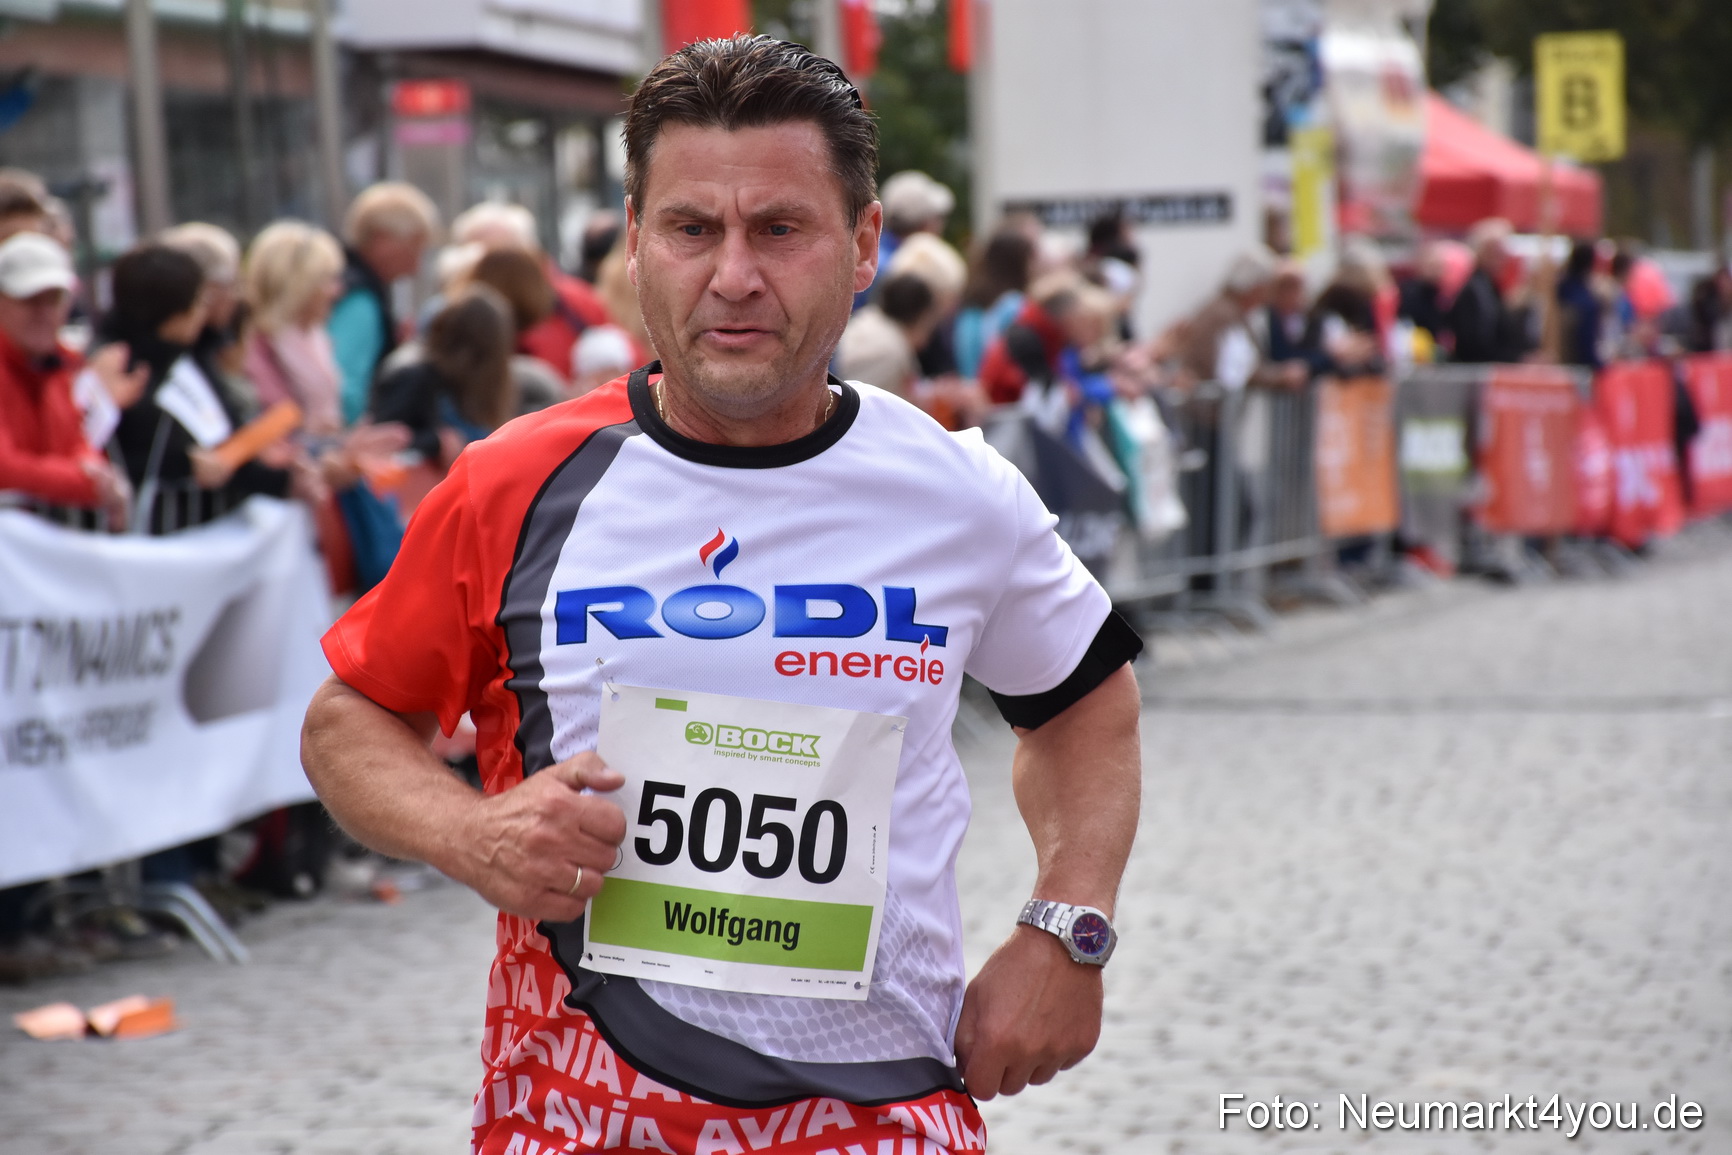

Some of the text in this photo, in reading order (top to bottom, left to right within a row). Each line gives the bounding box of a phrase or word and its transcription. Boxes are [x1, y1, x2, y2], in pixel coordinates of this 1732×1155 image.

[713, 748, 821, 768] inspired by smart concepts
[714, 724, 822, 759] BOCK
[633, 780, 849, 885] 5050
[663, 900, 801, 951] Wolfgang
